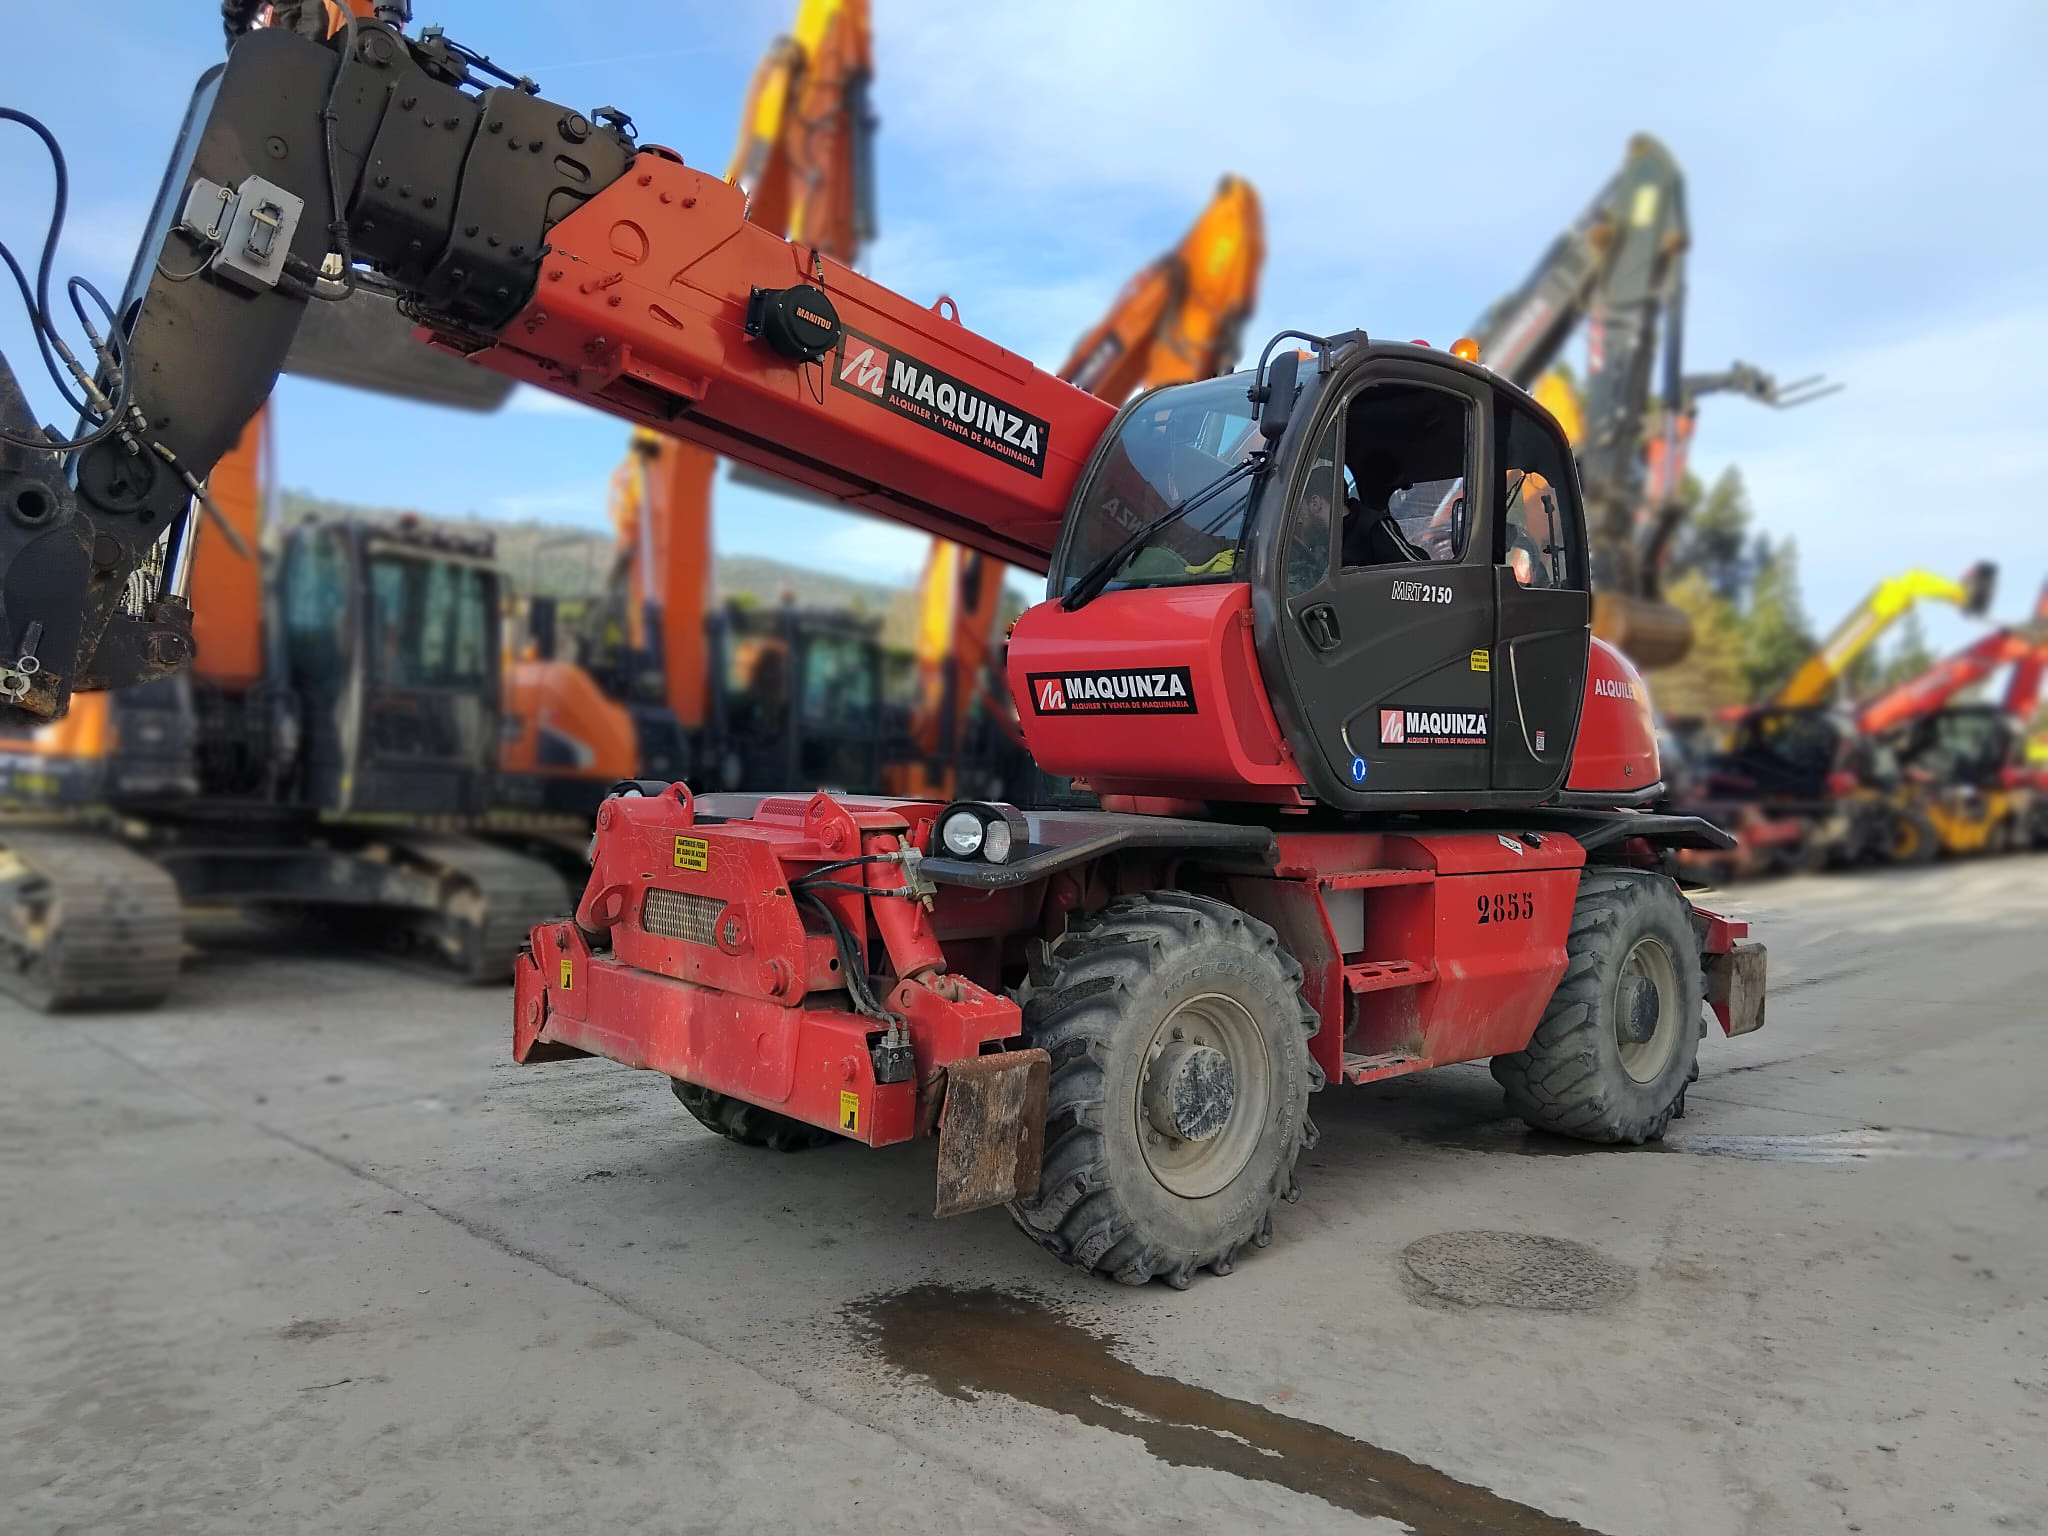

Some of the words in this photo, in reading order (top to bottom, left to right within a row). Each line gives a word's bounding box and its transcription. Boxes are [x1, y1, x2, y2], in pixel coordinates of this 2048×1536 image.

[796, 307, 832, 330] MANITOU
[891, 359, 1039, 455] MAQUINZA
[888, 394, 931, 420] ALQUILER
[933, 413, 940, 424] Y
[941, 418, 969, 437] VENTA
[970, 431, 981, 444] DE
[983, 436, 1036, 467] MAQUINARIA
[1064, 674, 1187, 699] MAQUINZA
[1406, 712, 1487, 735] MAQUINZA
[1477, 892, 1534, 924] 2855
